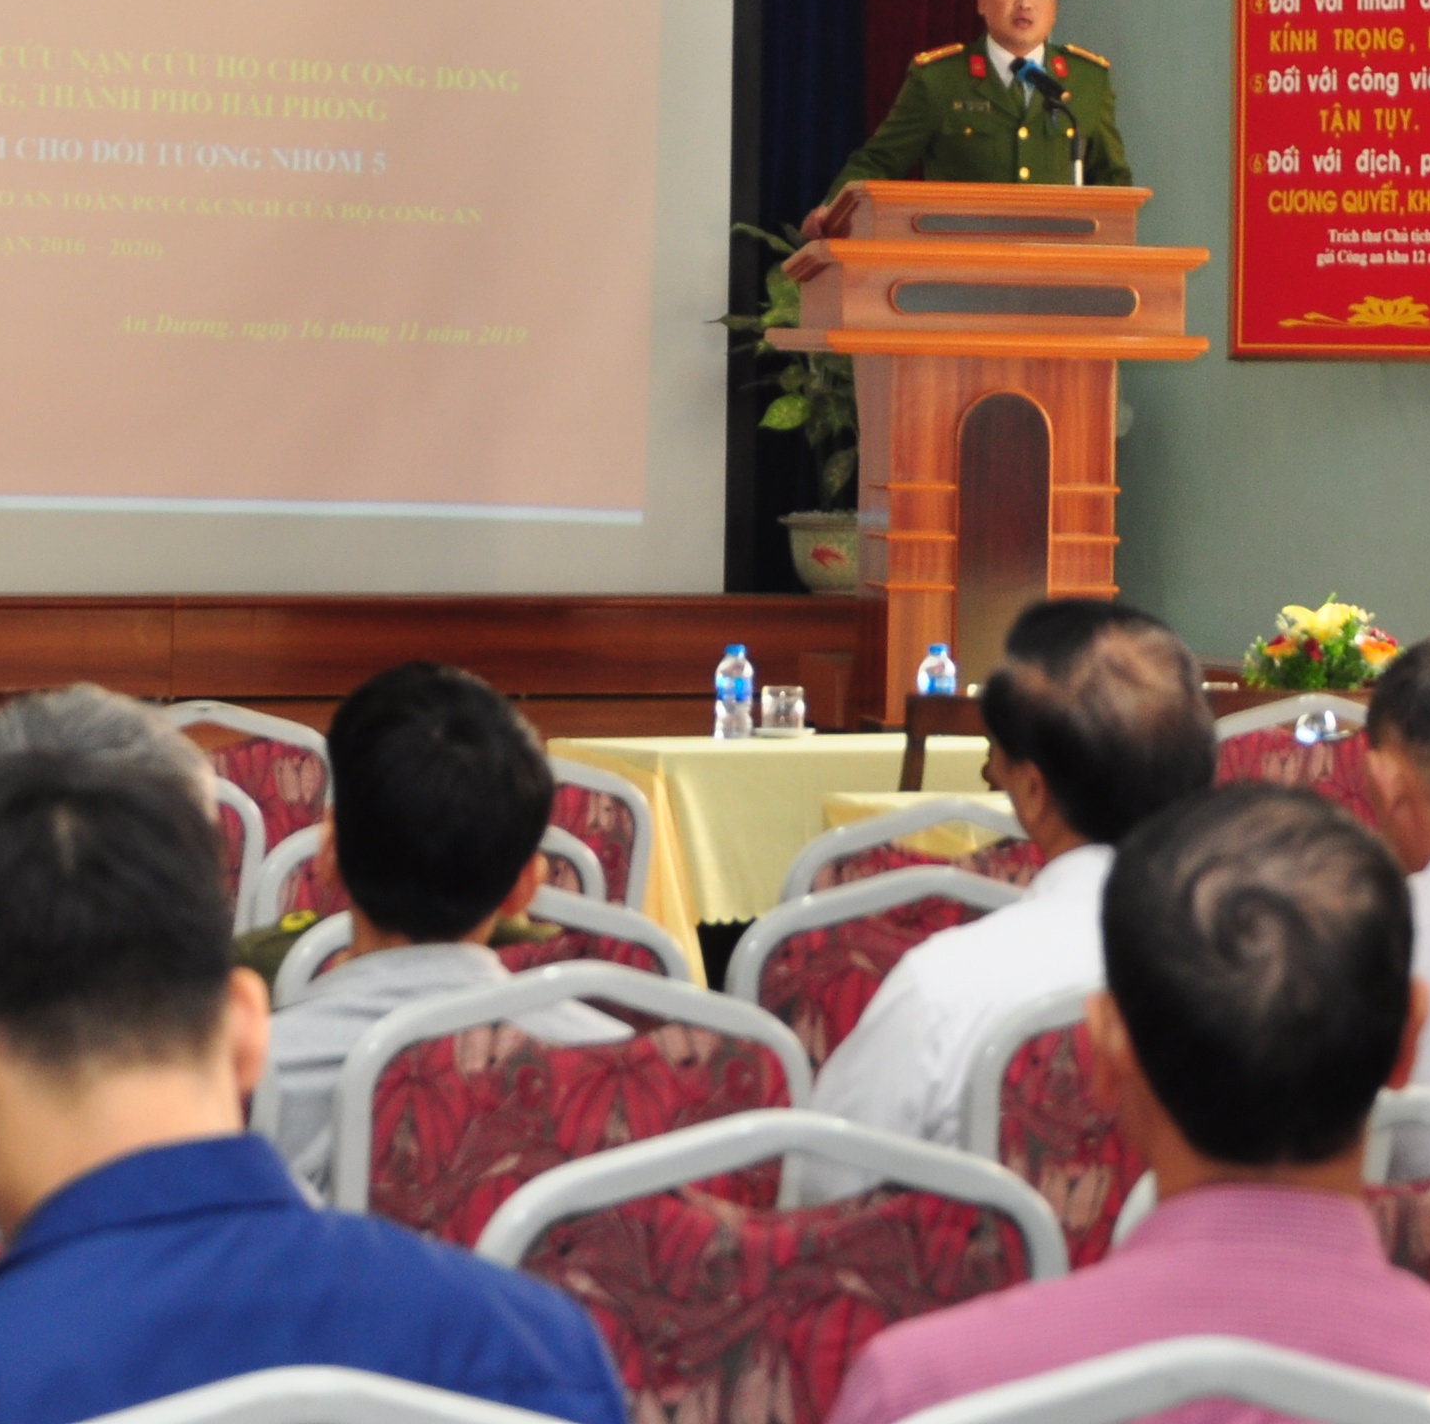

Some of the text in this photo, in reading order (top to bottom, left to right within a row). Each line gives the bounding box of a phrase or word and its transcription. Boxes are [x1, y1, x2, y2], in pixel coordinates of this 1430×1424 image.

[1271, 22, 1317, 52] KÍNH
[1334, 27, 1415, 58] TRỌNG,
[267, 57, 334, 83] CHO
[1268, 65, 1300, 93] Đối
[1308, 66, 1337, 92] với
[1347, 67, 1400, 97] công
[1320, 102, 1419, 138] TẬN TỤY.
[15, 136, 83, 162] CHO
[372, 151, 387, 175] 5
[1267, 145, 1299, 173] Đối
[1312, 147, 1341, 172] với
[1356, 148, 1410, 178] địch,
[1268, 189, 1337, 213] CƯƠNG
[1328, 228, 1360, 243] Trích
[1370, 252, 1384, 263] an
[1386, 250, 1409, 263] khu
[1412, 250, 1425, 263] 12
[119, 313, 148, 333] An
[300, 318, 324, 339] 16
[477, 324, 529, 345] 2019
